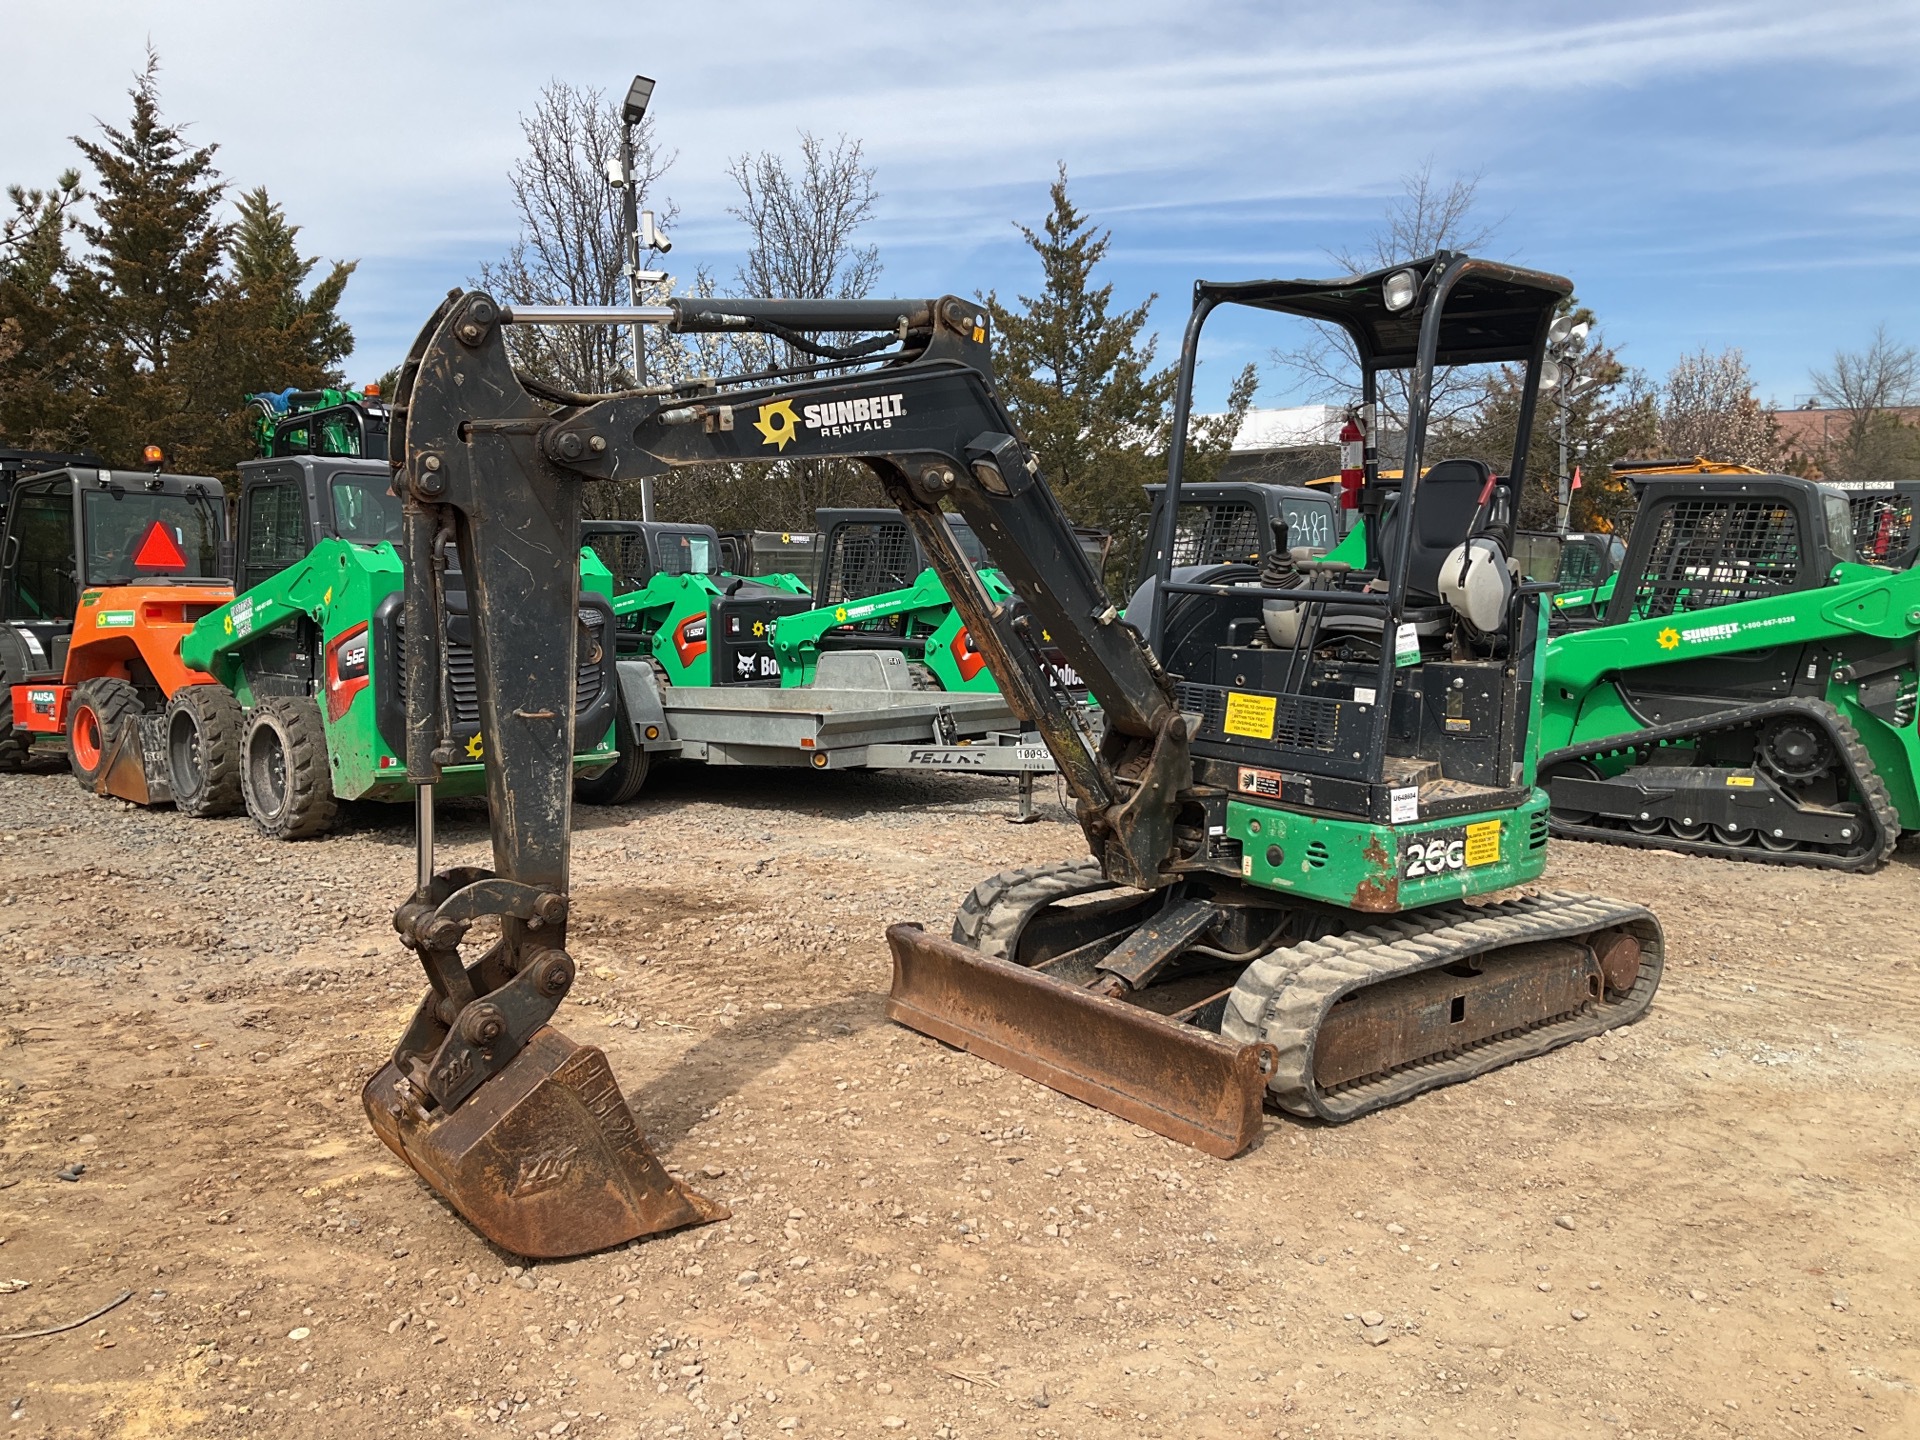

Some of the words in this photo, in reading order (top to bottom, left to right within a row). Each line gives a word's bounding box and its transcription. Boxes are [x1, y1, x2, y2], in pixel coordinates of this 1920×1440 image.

[804, 394, 903, 428] SUNBELT
[821, 419, 892, 437] RENTALS
[1289, 511, 1328, 541] 3487
[1682, 623, 1740, 641] SUNBELT
[1690, 634, 1732, 644] RENTALS
[346, 647, 366, 667] S62
[33, 692, 55, 701] AUSA
[1018, 749, 1050, 759] 10093
[1406, 840, 1464, 877] 26G
